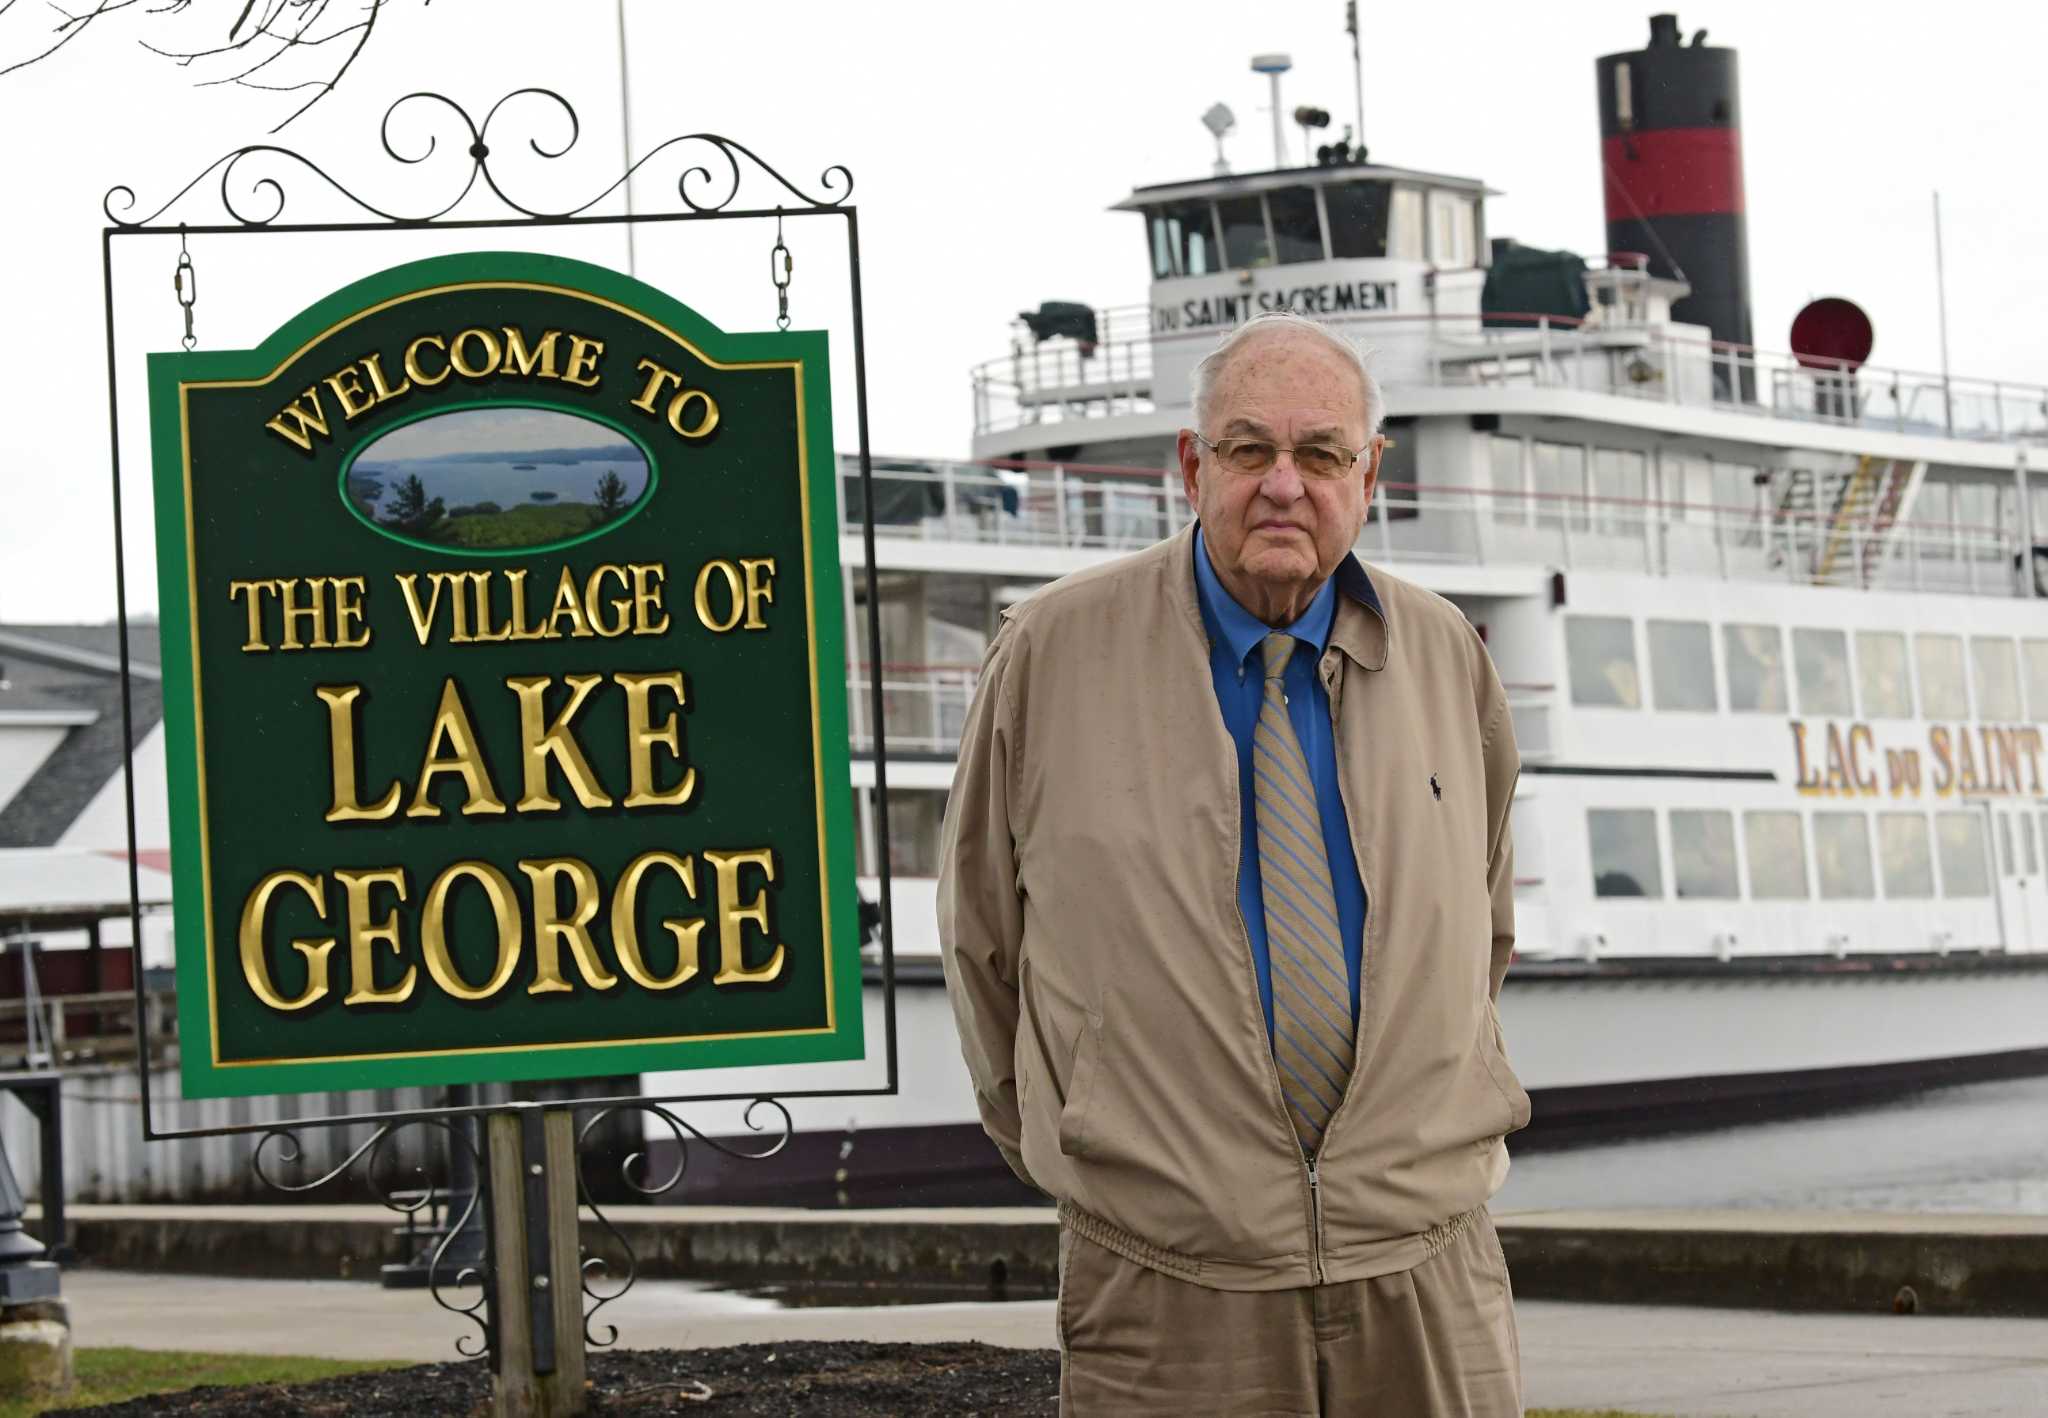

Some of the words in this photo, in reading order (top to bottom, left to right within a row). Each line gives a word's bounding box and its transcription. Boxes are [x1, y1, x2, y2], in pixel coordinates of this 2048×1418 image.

[1184, 294, 1251, 327] SAINT
[1258, 280, 1397, 315] SACREMENT
[265, 326, 604, 453] WELCOME
[630, 357, 720, 440] TO
[230, 576, 371, 653] THE
[395, 563, 670, 647] VILLAGE
[694, 557, 776, 634] OF
[316, 671, 696, 823] LAKE
[1789, 721, 1878, 797] LAC
[1885, 747, 1921, 798] DU
[1929, 724, 2044, 799] SAINT
[239, 847, 785, 1011] GEORGE
